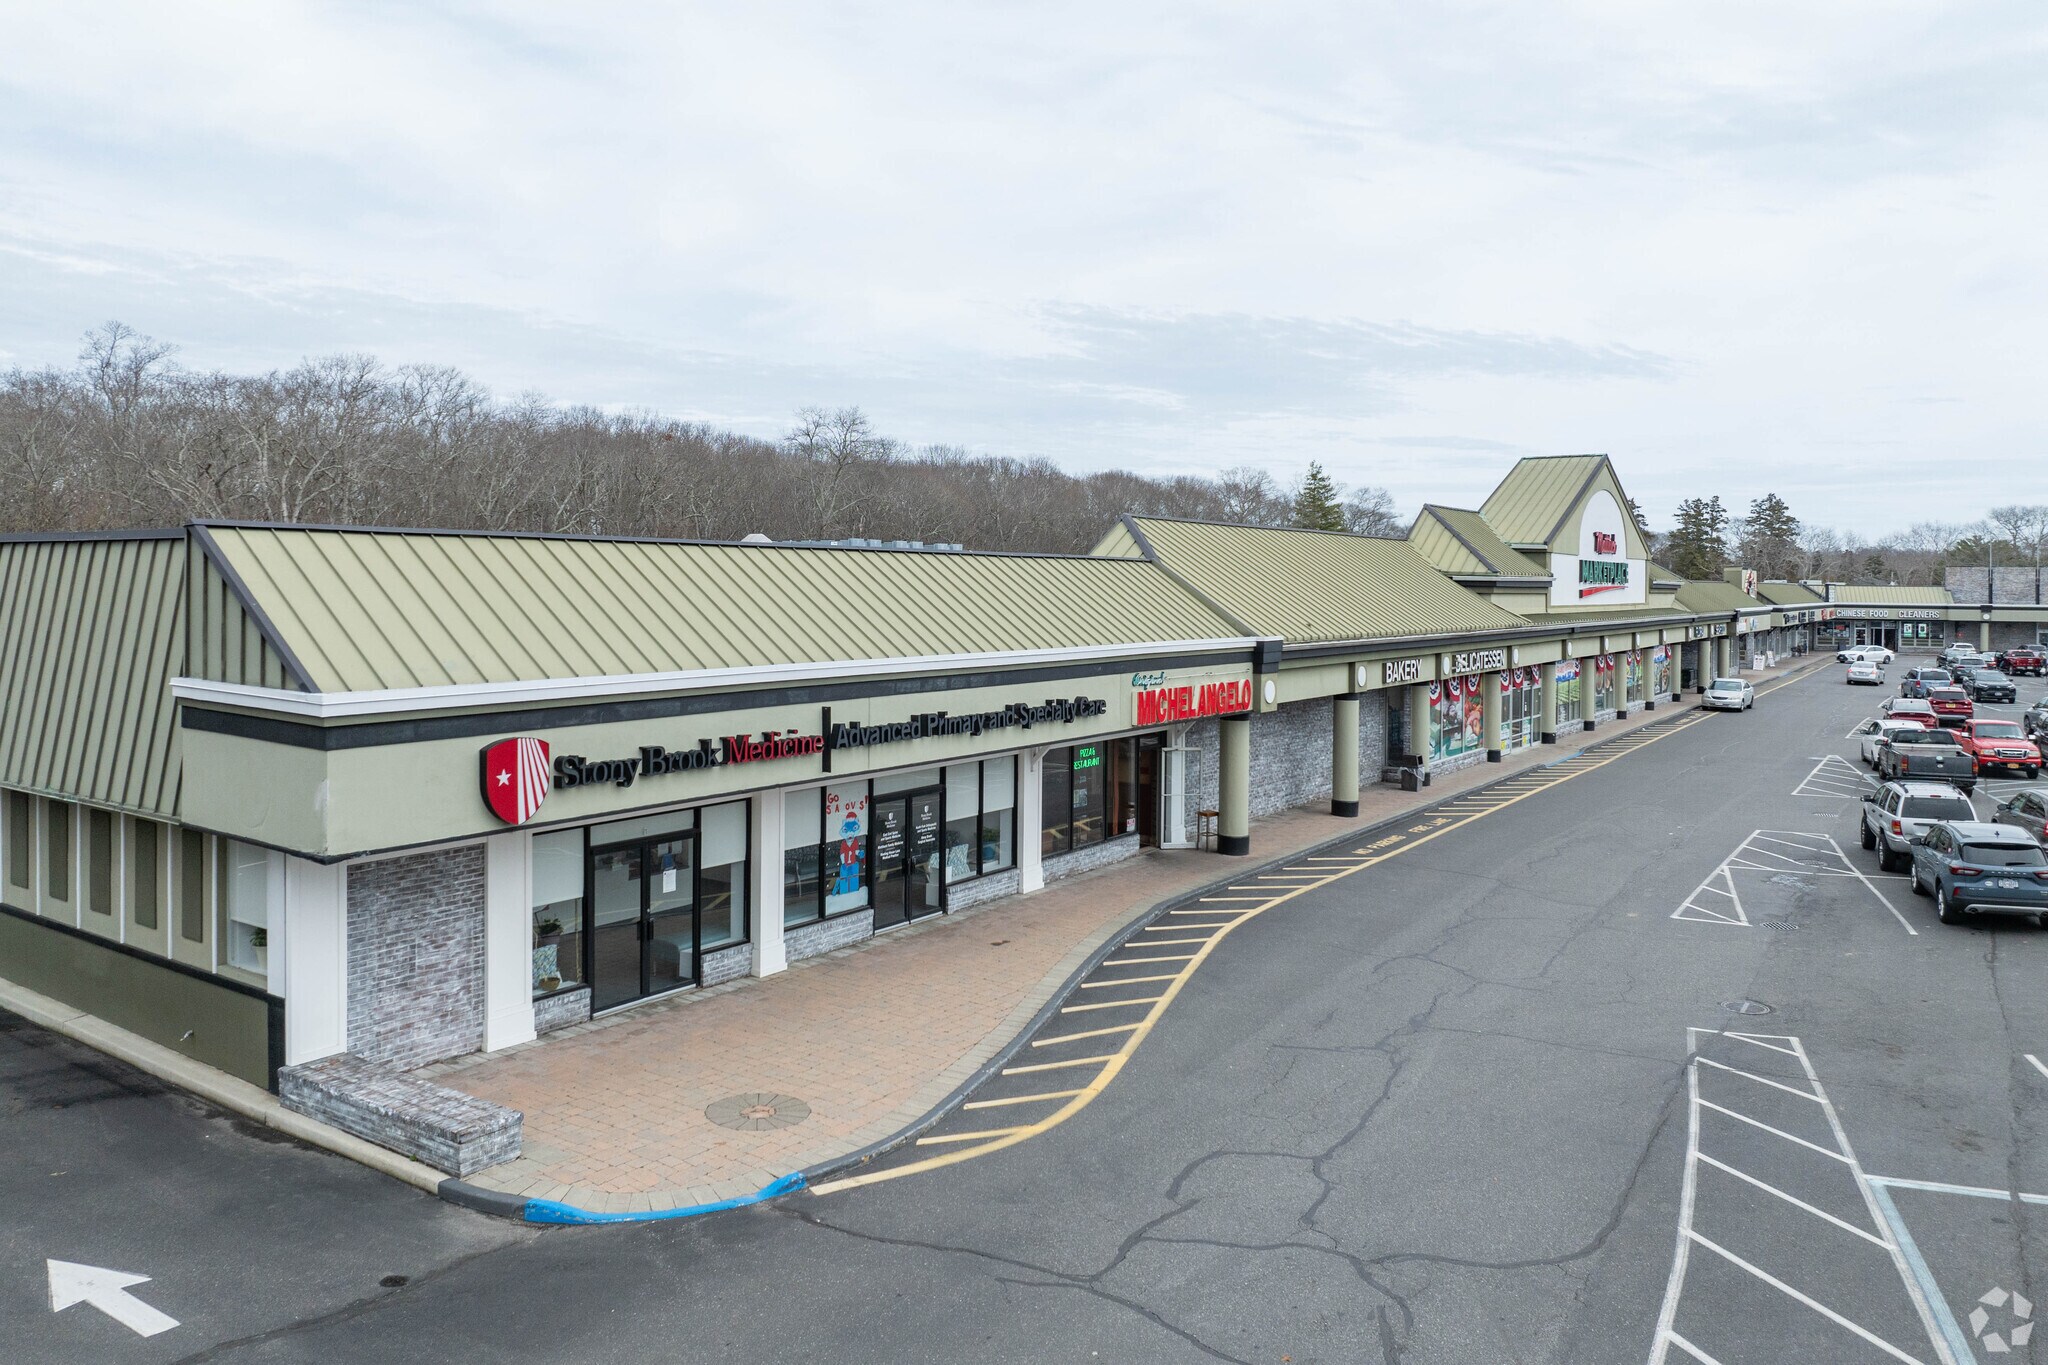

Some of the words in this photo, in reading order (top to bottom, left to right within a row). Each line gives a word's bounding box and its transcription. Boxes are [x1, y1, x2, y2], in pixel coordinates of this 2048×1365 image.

[1580, 560, 1629, 585] MARKETPLACE
[1836, 609, 1866, 618] CHINESE
[1869, 609, 1889, 618] FOOD
[1898, 610, 1940, 619] CLEANERS
[1385, 658, 1423, 684] BAKERY
[1454, 649, 1505, 674] DELICATESSEN
[831, 713, 921, 749] Advanced
[921, 710, 984, 737] Primary
[986, 704, 1016, 730] and
[1015, 698, 1076, 729] Specialty
[1075, 696, 1107, 718] Care
[554, 755, 641, 789] Stony
[639, 738, 722, 777] Brook
[721, 728, 825, 766] Medicine
